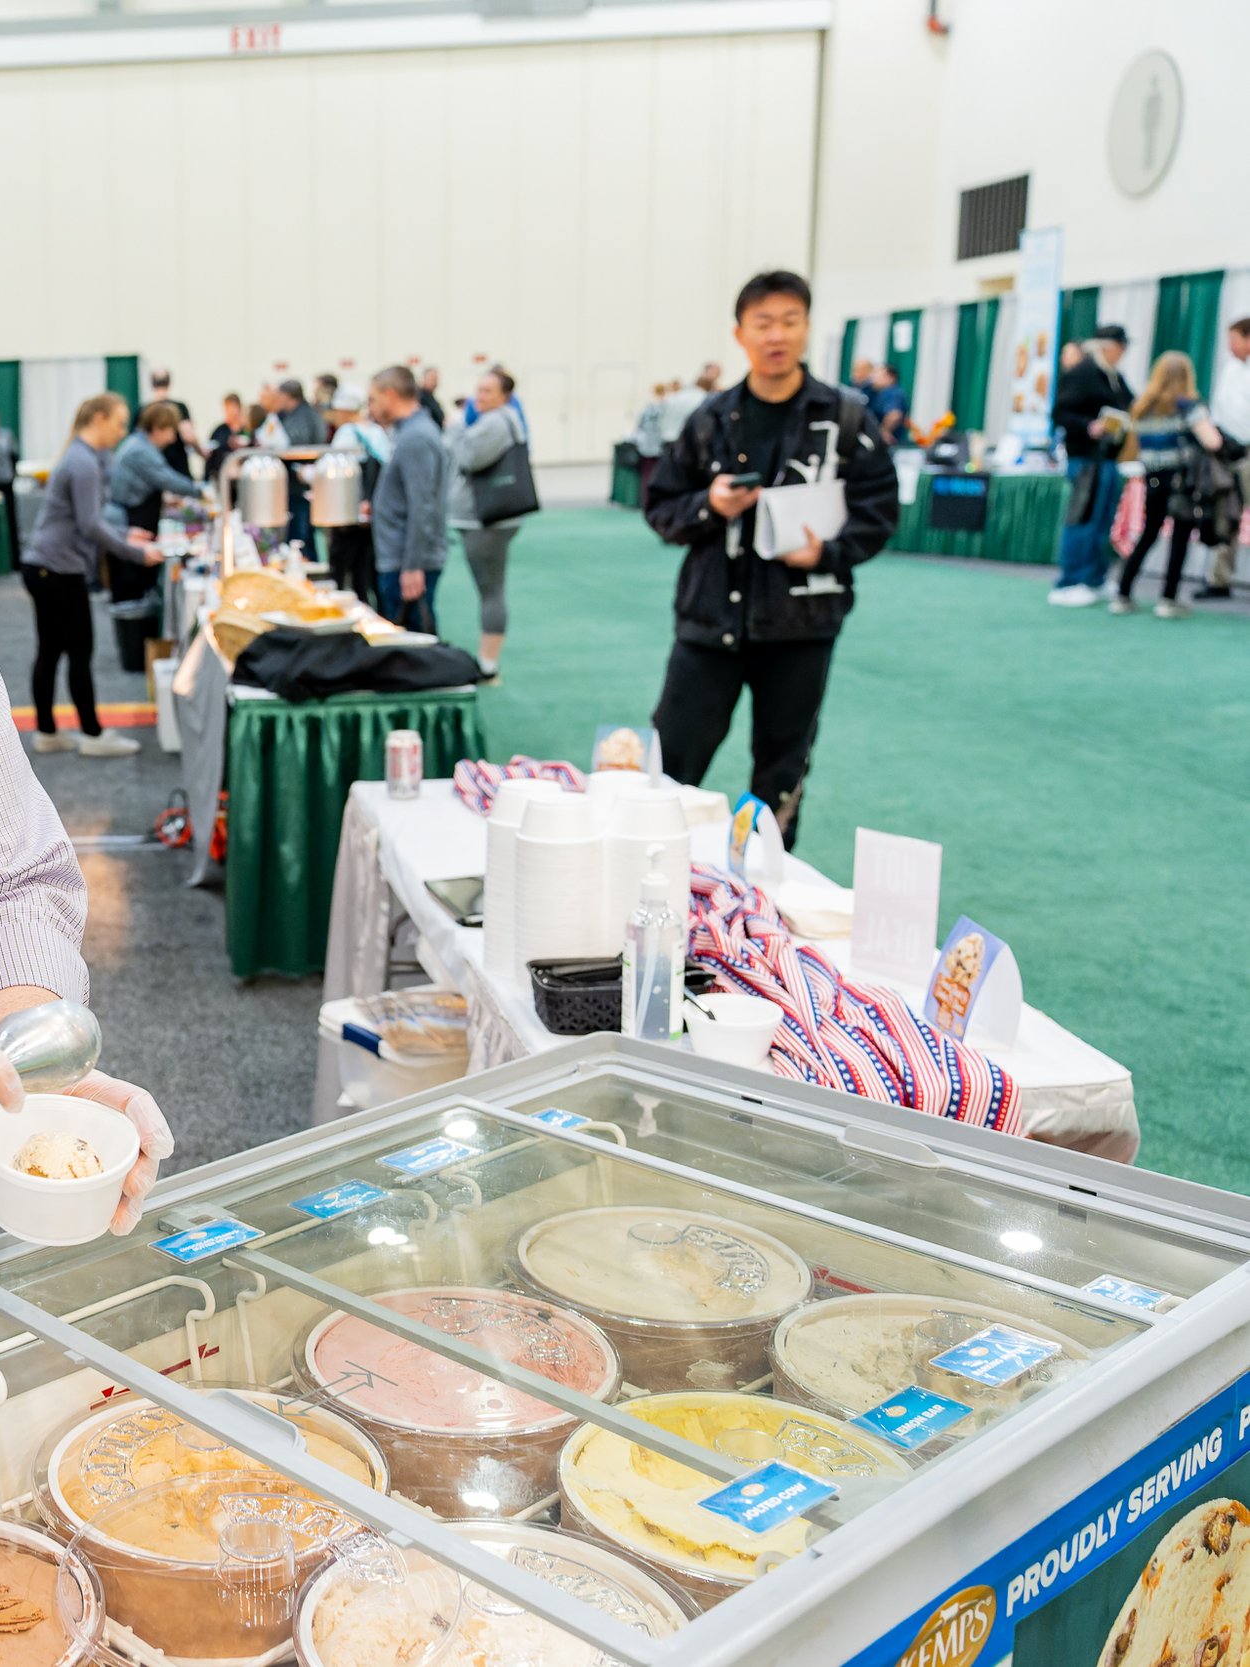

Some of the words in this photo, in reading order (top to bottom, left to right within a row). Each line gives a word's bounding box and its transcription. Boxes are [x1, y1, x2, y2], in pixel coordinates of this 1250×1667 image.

[891, 1414, 927, 1437] LEMON
[924, 1403, 946, 1421] BAR
[741, 1495, 783, 1521] JOLTED
[777, 1482, 807, 1500] COW
[1005, 1500, 1124, 1617] PROUDLY
[1126, 1426, 1223, 1524] SERVING
